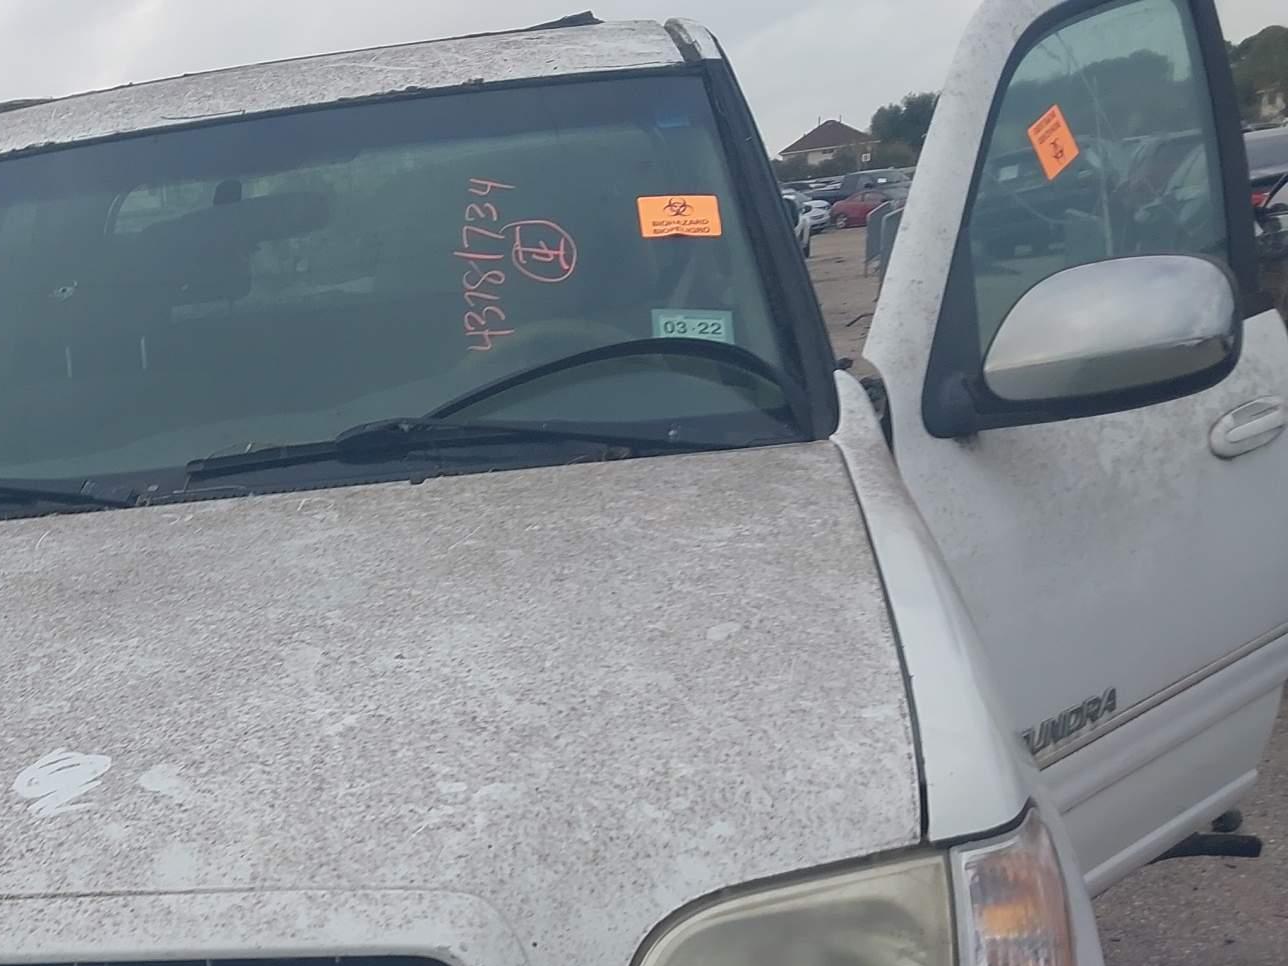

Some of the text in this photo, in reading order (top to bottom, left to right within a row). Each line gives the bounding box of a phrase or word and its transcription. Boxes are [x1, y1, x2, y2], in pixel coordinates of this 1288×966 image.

[652, 218, 710, 227] BIOHAZARD
[453, 178, 516, 351] 43781734
[1021, 687, 1117, 756] UNDRA
